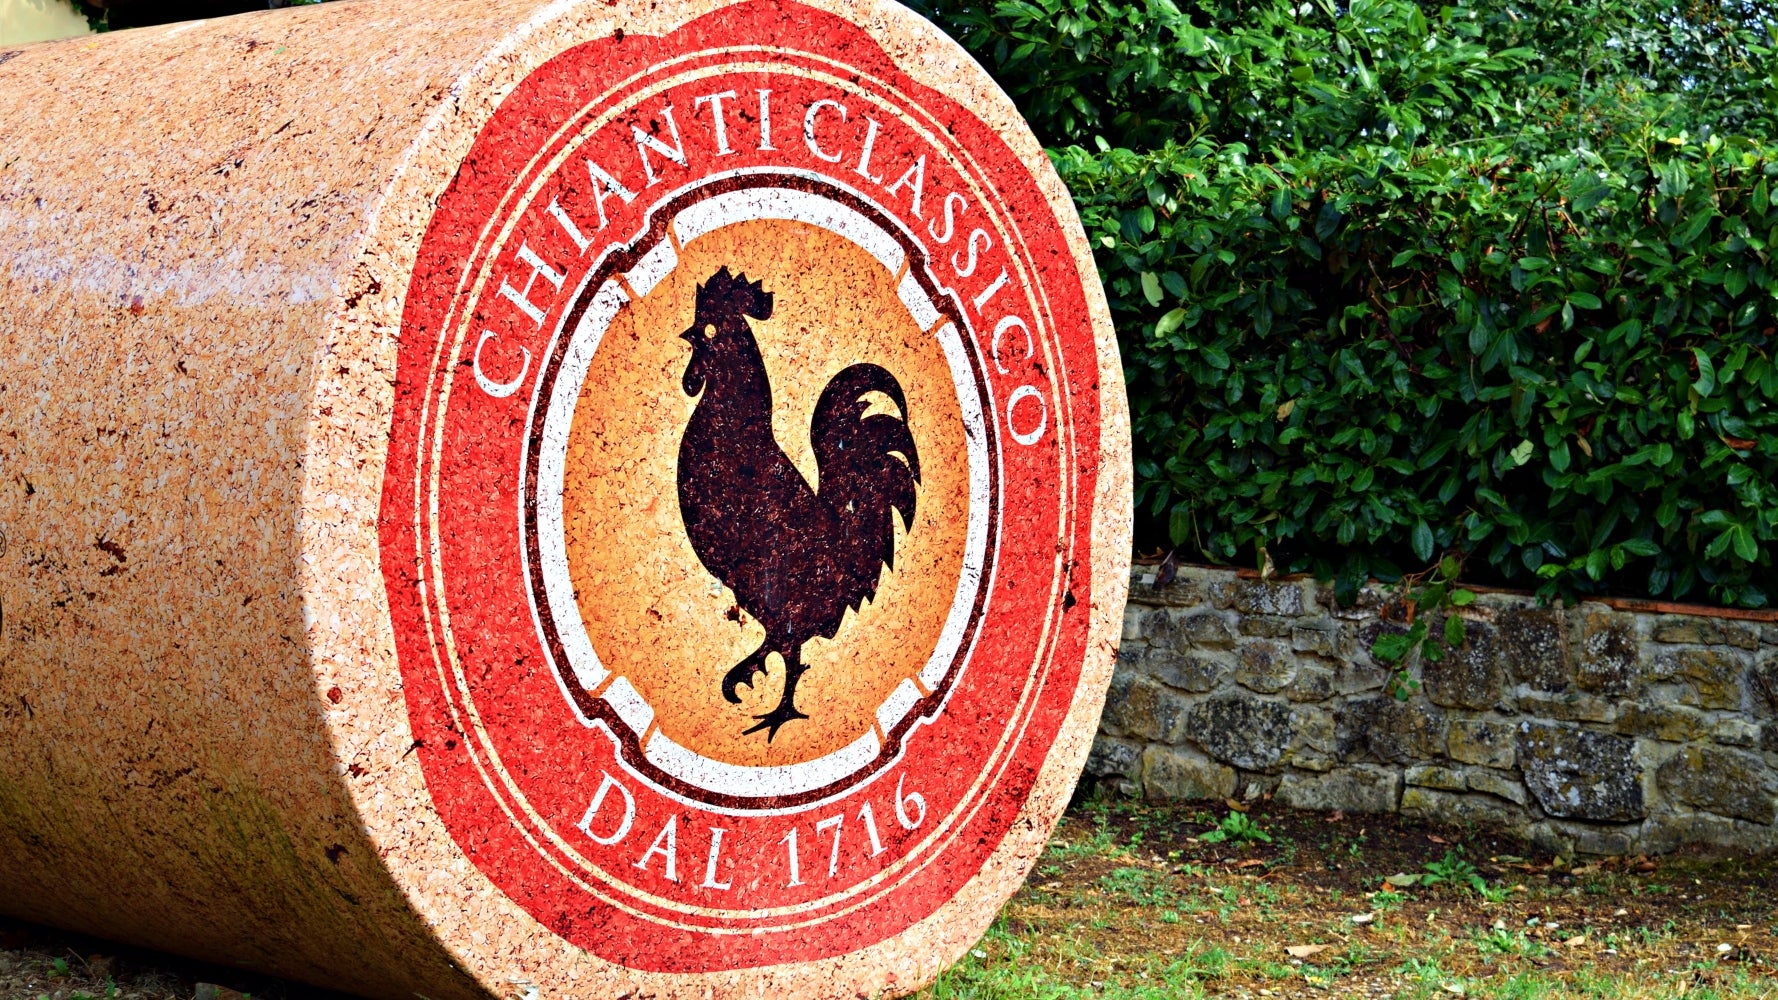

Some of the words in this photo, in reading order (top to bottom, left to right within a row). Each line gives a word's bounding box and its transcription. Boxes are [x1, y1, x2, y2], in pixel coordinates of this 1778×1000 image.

[473, 89, 777, 399] CHIANTI
[803, 99, 1048, 446] CLASSICO
[574, 769, 733, 891] DAL
[779, 771, 927, 889] 1716
